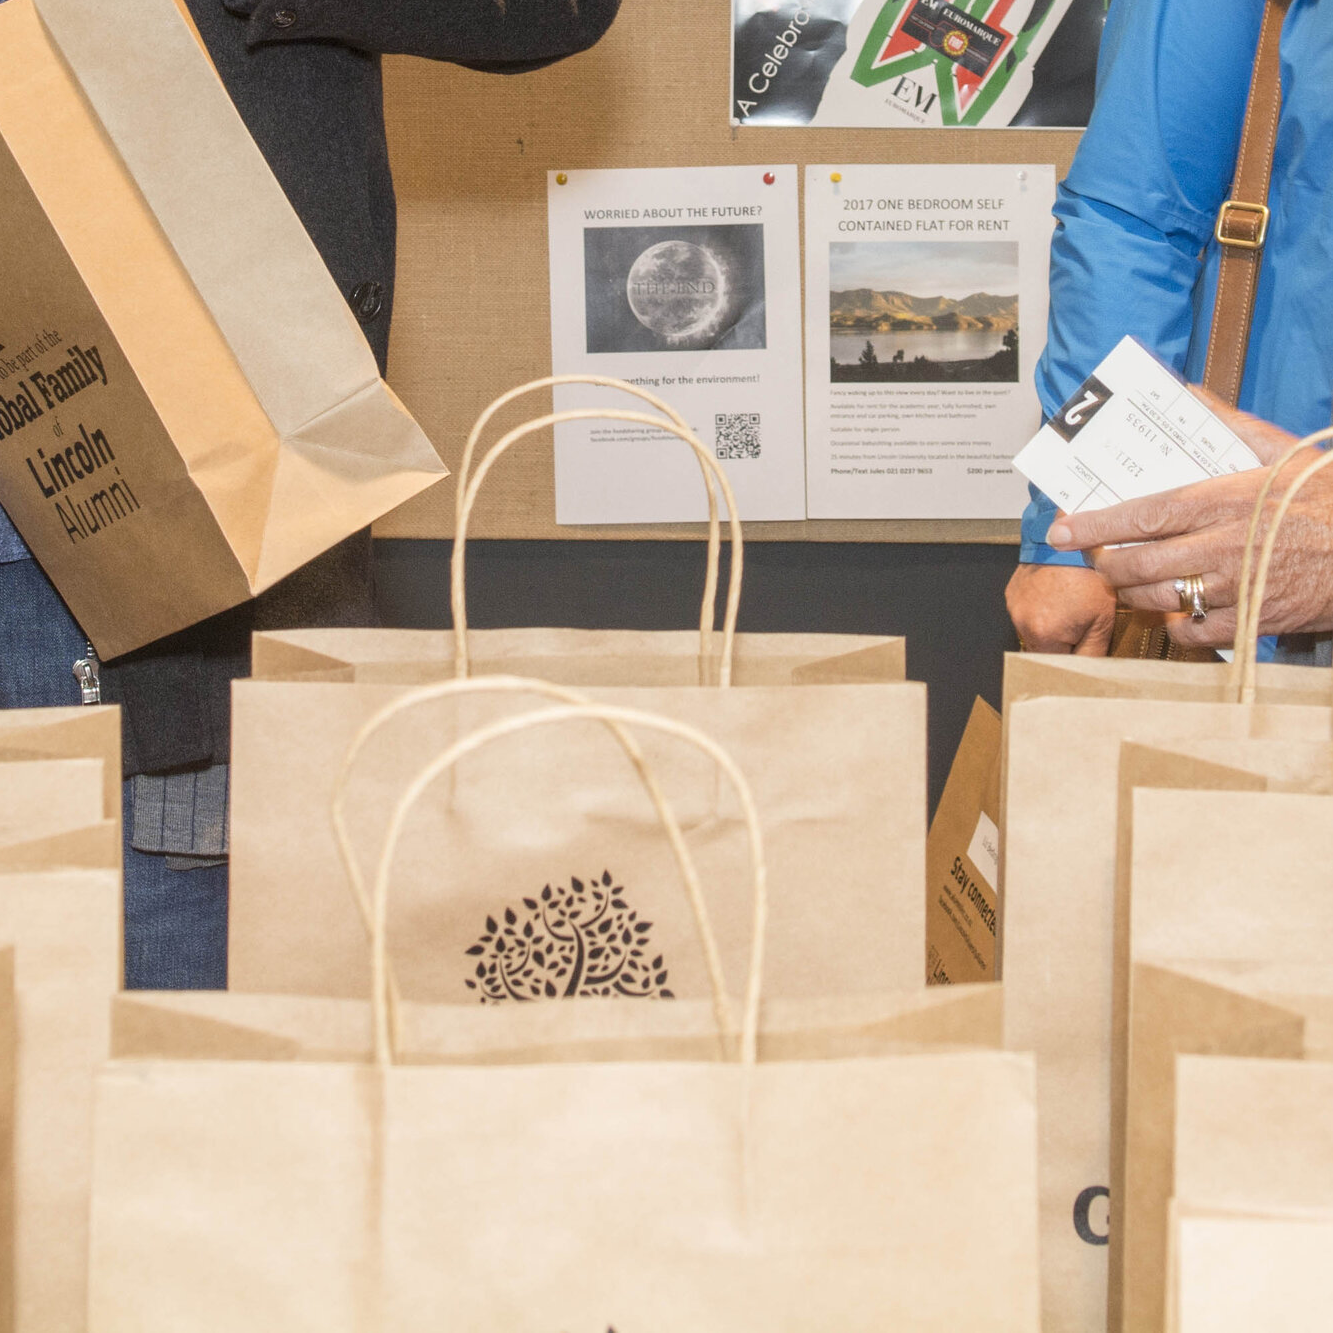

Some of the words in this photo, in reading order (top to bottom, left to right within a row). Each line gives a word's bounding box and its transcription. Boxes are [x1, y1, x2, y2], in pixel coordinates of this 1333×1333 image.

[943, 8, 1002, 47] EUROMARQUE
[737, 99, 758, 117] A
[891, 76, 938, 116] EM
[584, 209, 639, 220] WORRIED
[643, 208, 683, 219] ABOUT
[687, 207, 708, 218] THE
[711, 205, 763, 217] FUTURE?
[843, 199, 873, 210] 2017
[877, 199, 904, 210] ONE
[907, 199, 974, 210] BEDROOM
[977, 199, 1005, 210] SELF
[838, 220, 912, 231] CONTAINED
[916, 220, 945, 231] FLAT
[949, 220, 974, 231] FOR
[977, 220, 1010, 231] RENT
[0, 359, 17, 375] be
[17, 347, 39, 373] part
[35, 334, 48, 355] of
[42, 328, 62, 348] the
[29, 344, 108, 411] Family
[624, 377, 660, 387] mething
[662, 375, 676, 385] for
[678, 375, 694, 385] the
[696, 374, 760, 385] environment!
[1064, 390, 1099, 426] 2
[52, 416, 64, 438] of
[1127, 413, 1157, 442] 11935
[26, 423, 116, 499] Lincoln
[55, 467, 141, 545] Alumni
[951, 856, 969, 894] Stay
[967, 882, 997, 938] connecte
